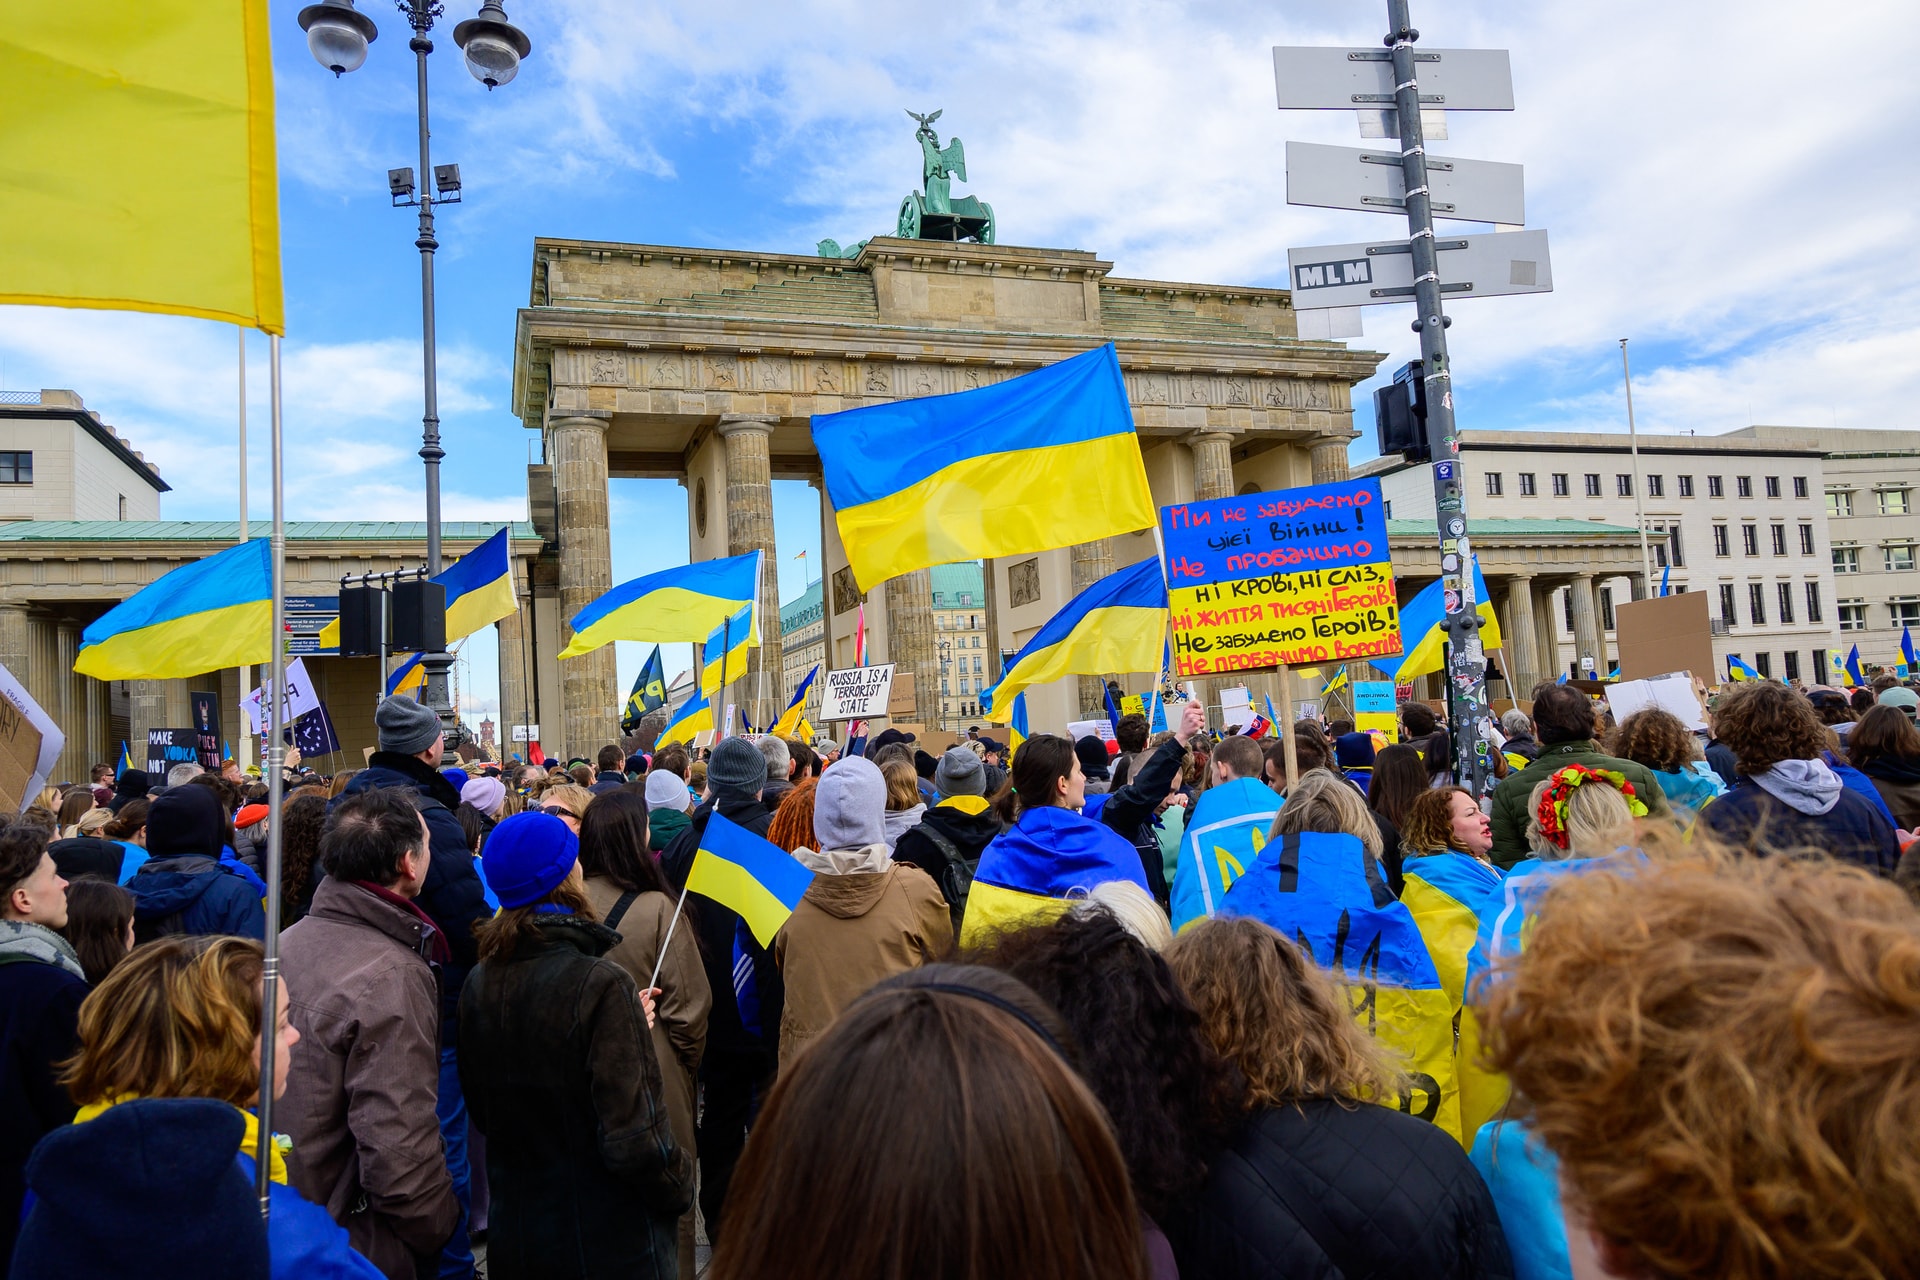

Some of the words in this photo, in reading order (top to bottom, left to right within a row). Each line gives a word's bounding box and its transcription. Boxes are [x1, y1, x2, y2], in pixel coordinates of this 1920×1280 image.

[1299, 261, 1368, 287] MLM
[1171, 505, 1211, 529] Ми
[1222, 507, 1246, 522] не
[1171, 556, 1206, 578] Не
[1175, 632, 1213, 653] Не
[1312, 606, 1397, 638] Героїв!
[1176, 655, 1211, 676] Не
[829, 671, 862, 687] RUSSIA
[867, 669, 880, 684] IS
[880, 668, 888, 682] A
[6, 688, 30, 715] FRAGILE
[834, 684, 881, 699] TERRORIST
[839, 698, 869, 714] STATE
[149, 731, 173, 745] MAKE
[164, 745, 199, 763] VODKA
[148, 759, 166, 774] NOT
